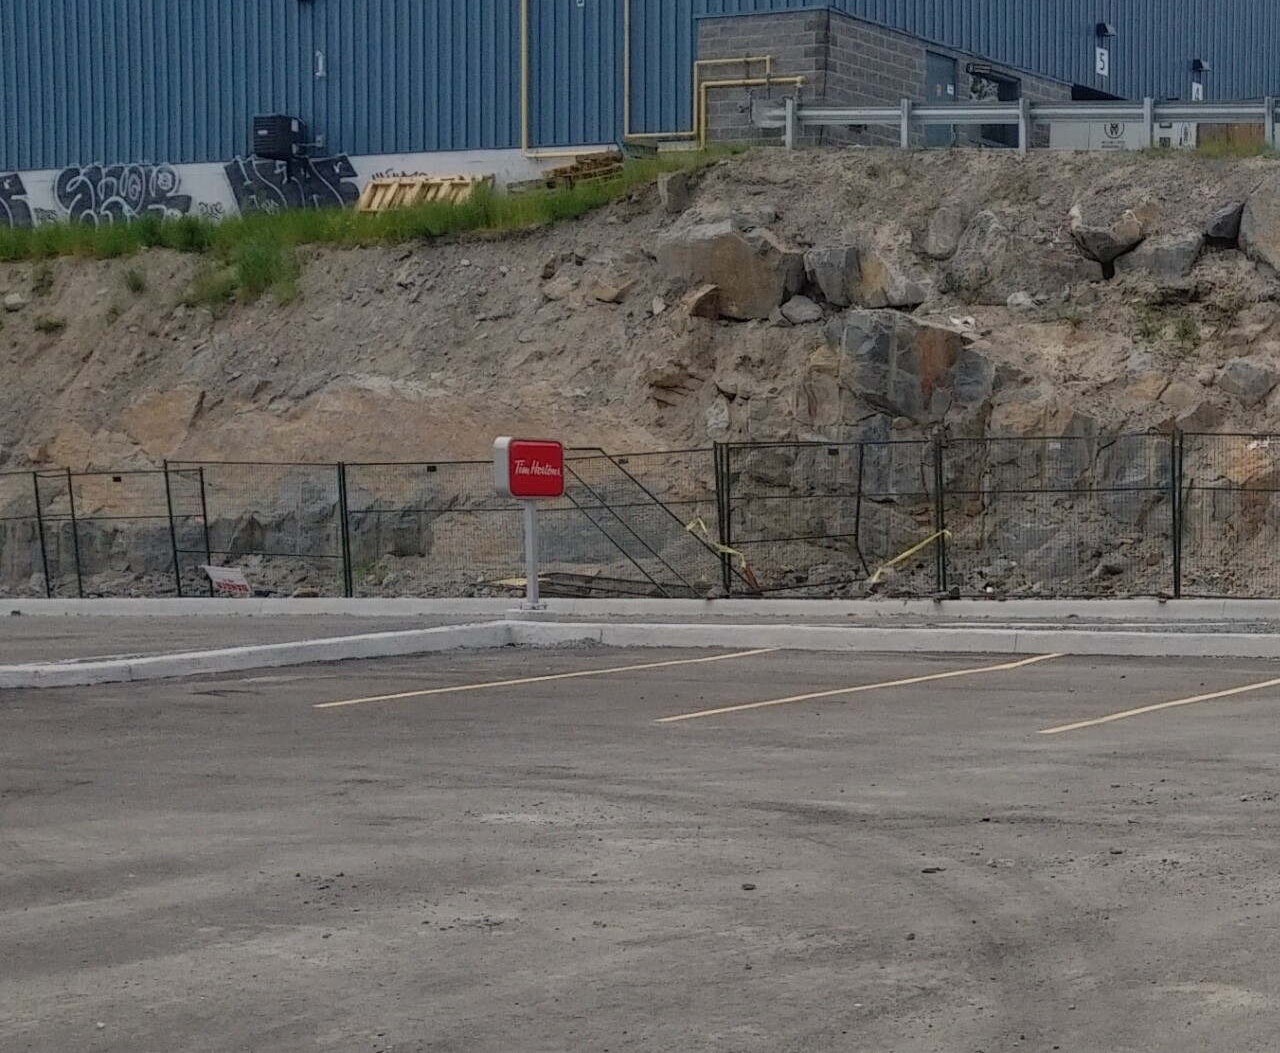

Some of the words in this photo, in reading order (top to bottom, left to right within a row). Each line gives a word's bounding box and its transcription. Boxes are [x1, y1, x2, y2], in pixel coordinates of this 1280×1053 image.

[1099, 53, 1106, 71] 5
[514, 459, 530, 475] Tim
[530, 459, 561, 476] Hortons
